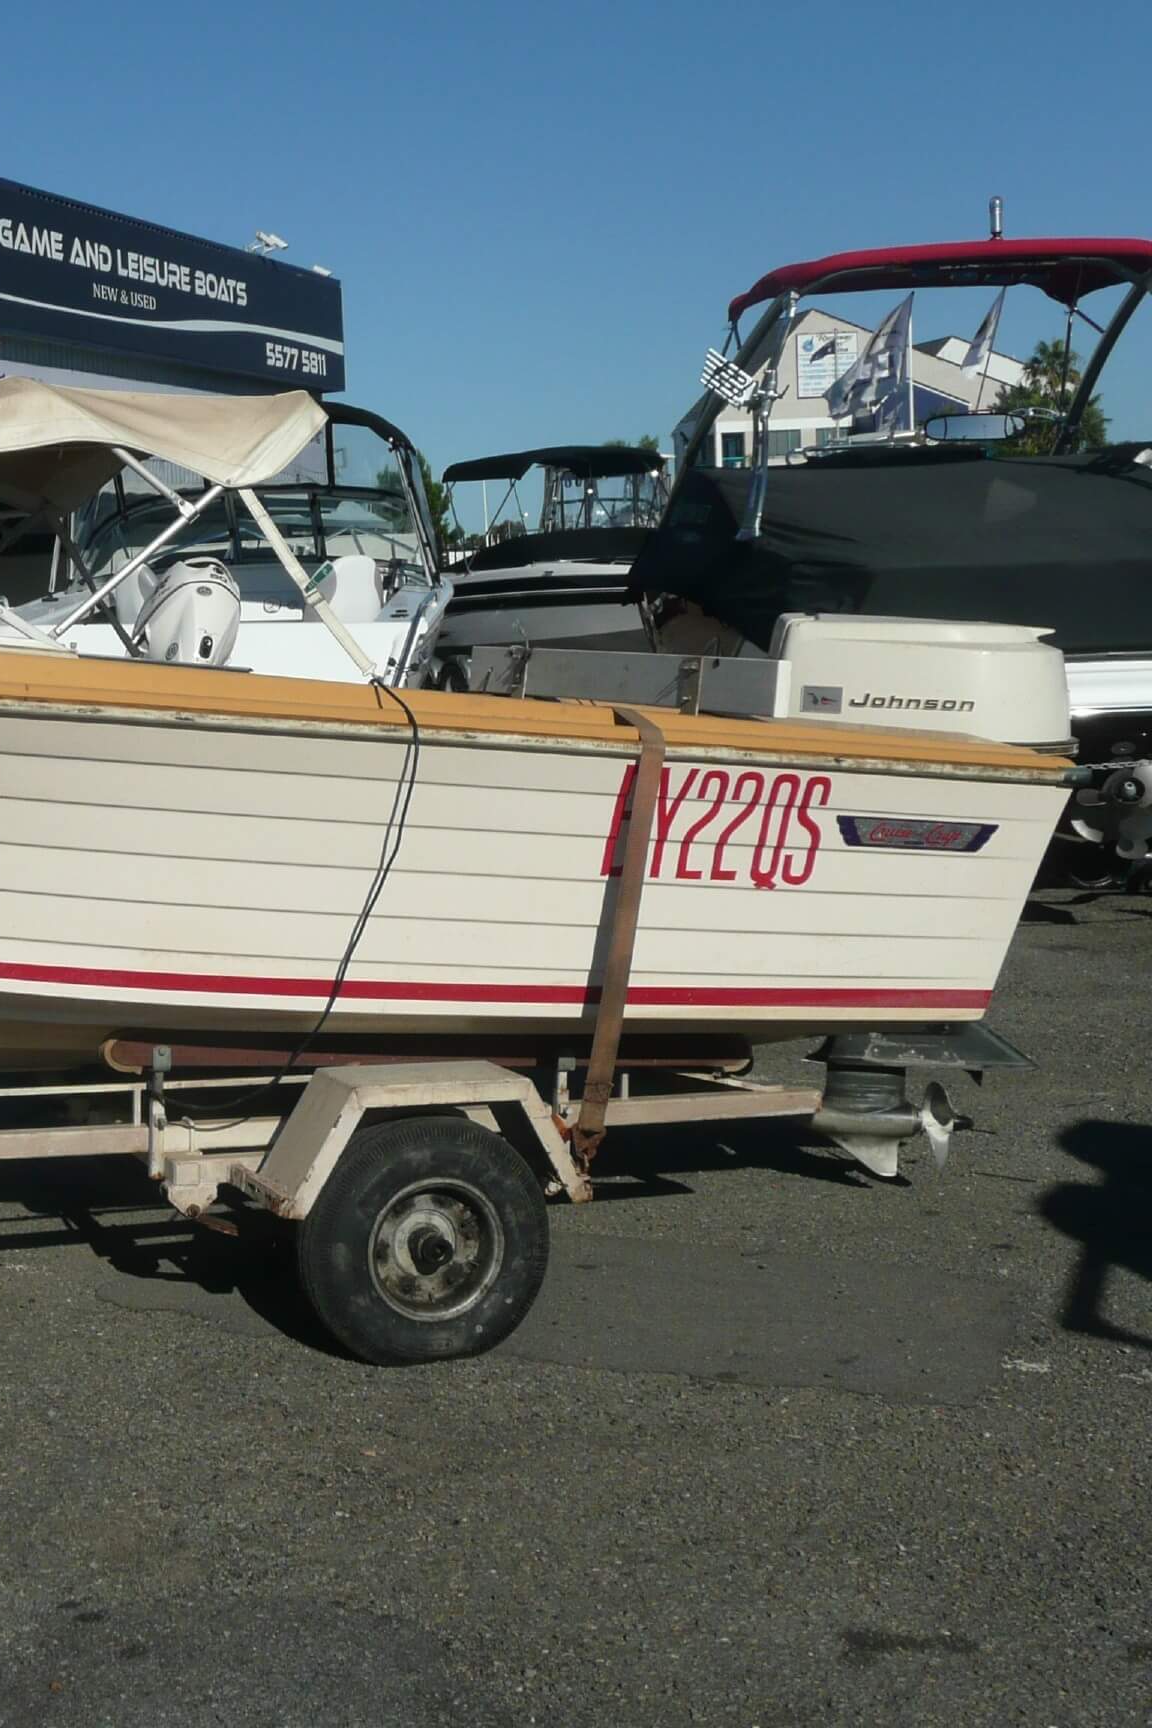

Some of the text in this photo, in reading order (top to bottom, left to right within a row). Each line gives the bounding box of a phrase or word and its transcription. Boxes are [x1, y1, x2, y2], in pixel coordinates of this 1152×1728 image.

[69, 237, 113, 273] AND
[116, 249, 192, 293] LEISURE
[194, 270, 249, 307] BOATS
[92, 283, 157, 311] NEW & USED
[265, 341, 327, 377] 5577 5811
[848, 692, 976, 713] Johnson
